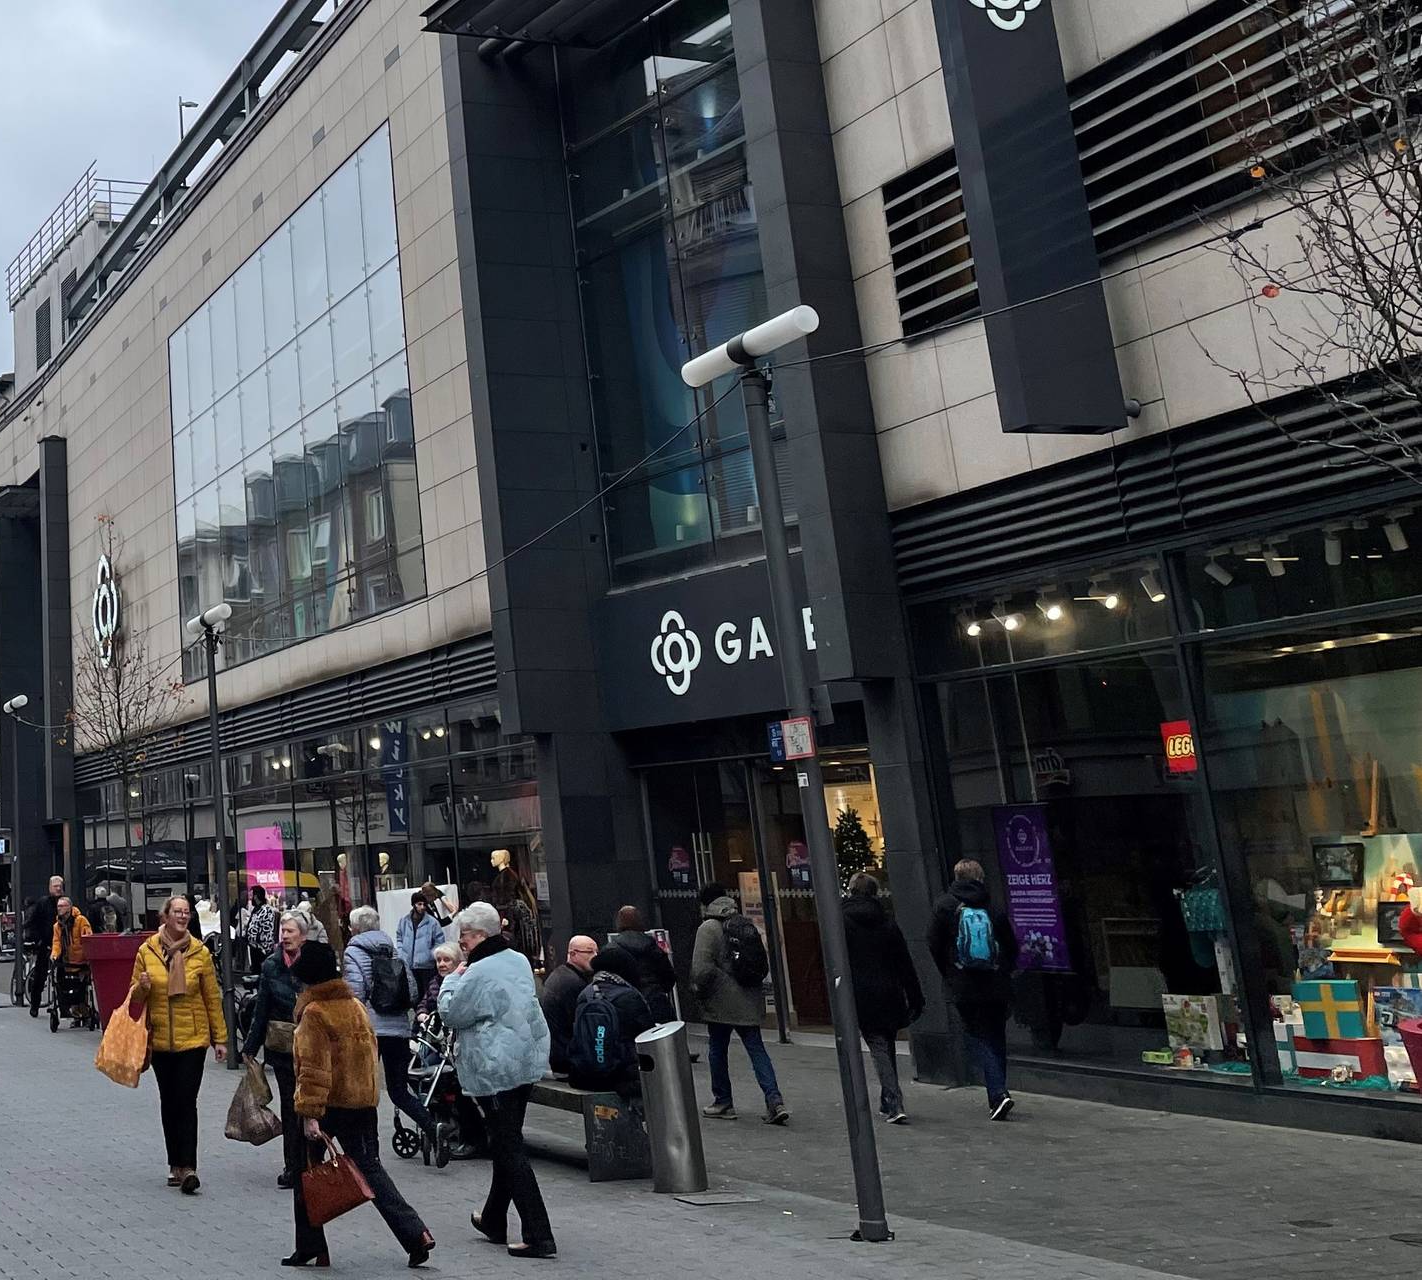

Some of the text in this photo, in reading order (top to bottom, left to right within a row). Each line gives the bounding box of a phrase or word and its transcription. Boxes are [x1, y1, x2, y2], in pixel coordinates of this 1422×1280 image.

[714, 607, 817, 664] GAE
[1007, 874, 1053, 886] ZEIGE HERZ
[594, 1025, 606, 1063] adidas
